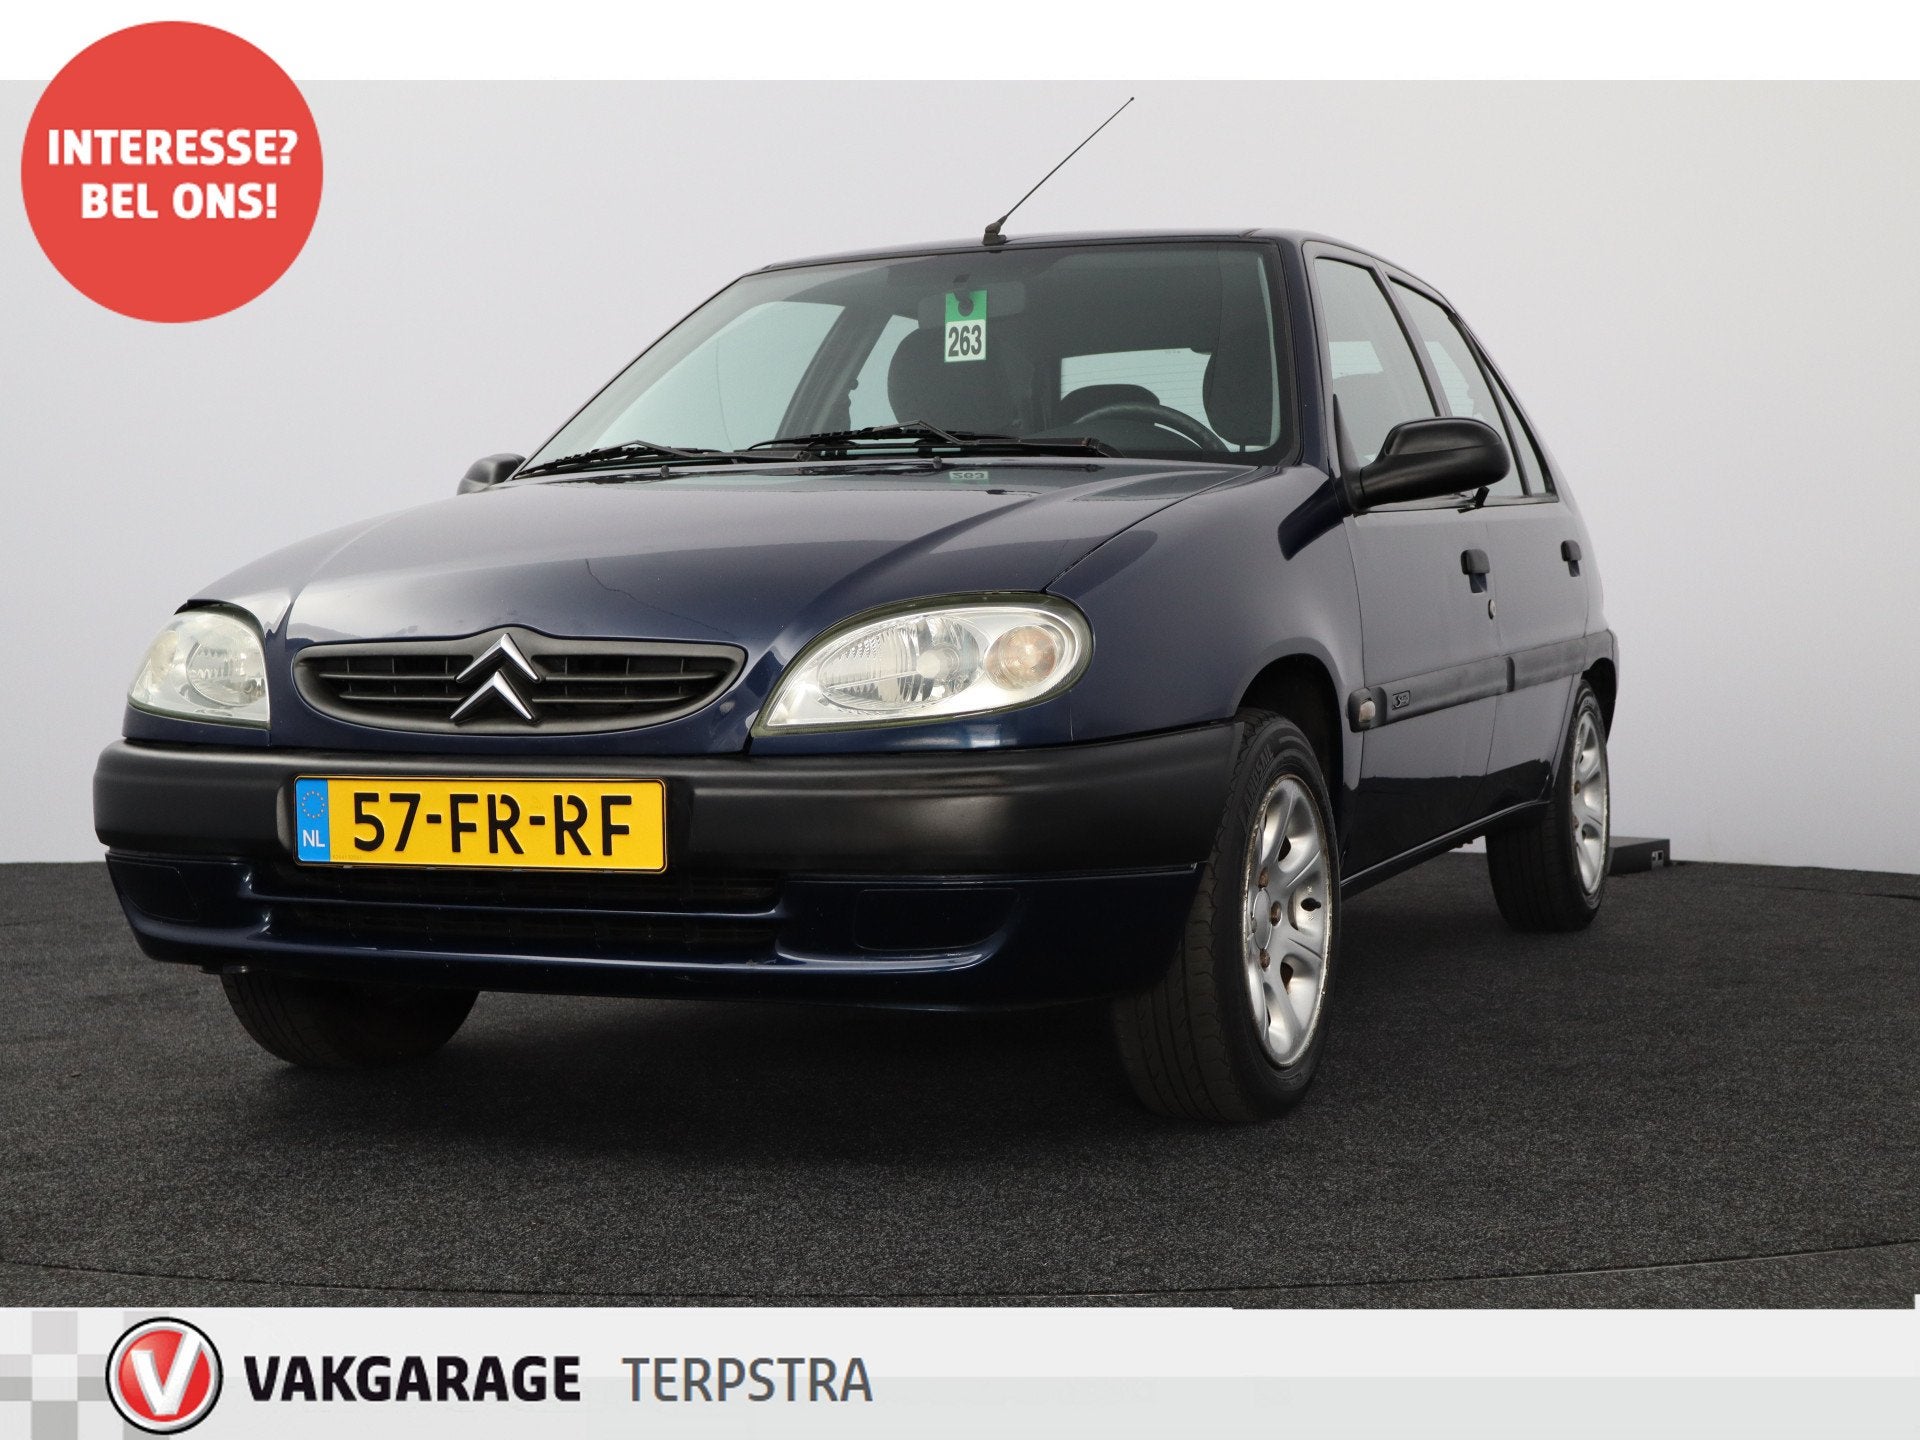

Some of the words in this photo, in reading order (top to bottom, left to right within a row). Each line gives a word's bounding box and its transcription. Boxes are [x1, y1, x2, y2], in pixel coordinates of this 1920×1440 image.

[948, 324, 982, 357] 263
[302, 829, 326, 848] NL
[353, 792, 632, 857] 57-FR-RF
